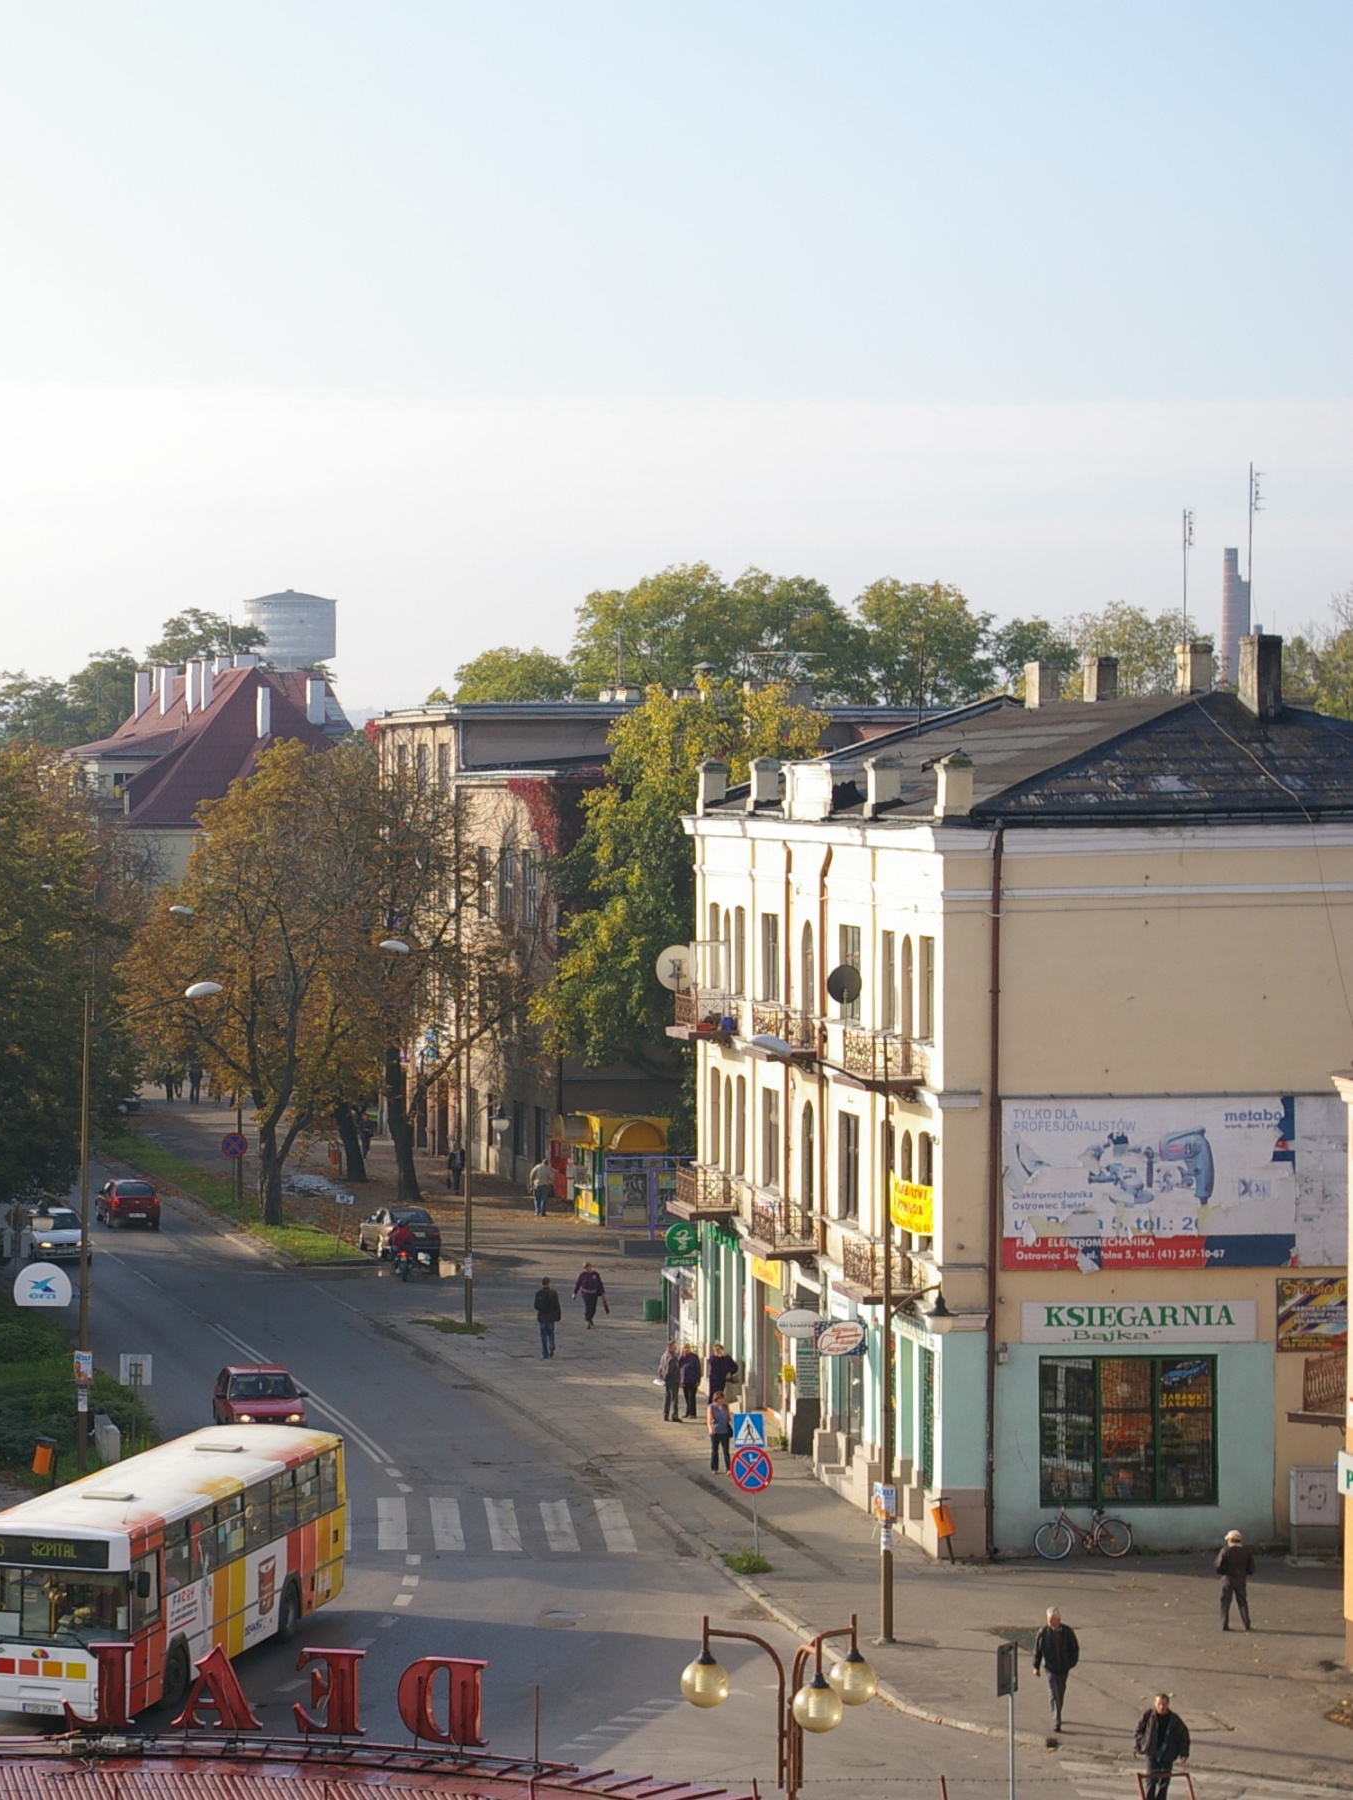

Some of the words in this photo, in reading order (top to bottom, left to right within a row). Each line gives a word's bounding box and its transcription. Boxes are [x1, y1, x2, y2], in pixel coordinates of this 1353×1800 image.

[1013, 1108, 1051, 1120] TYLKO
[1055, 1108, 1078, 1120] DLA
[1224, 1108, 1282, 1121] metabo
[1013, 1120, 1136, 1132] PROFESJONALISTÓW
[1012, 1201, 1058, 1210] Ostrowiec
[1016, 1251, 1061, 1260] Ostrowiec
[1157, 1249, 1177, 1260] (41)
[1179, 1249, 1225, 1260] 247-10-67
[28, 1292, 57, 1300] ora
[1044, 1304, 1236, 1329] KSIĘGARNIA
[31, 1540, 77, 1559] SZPITAL
